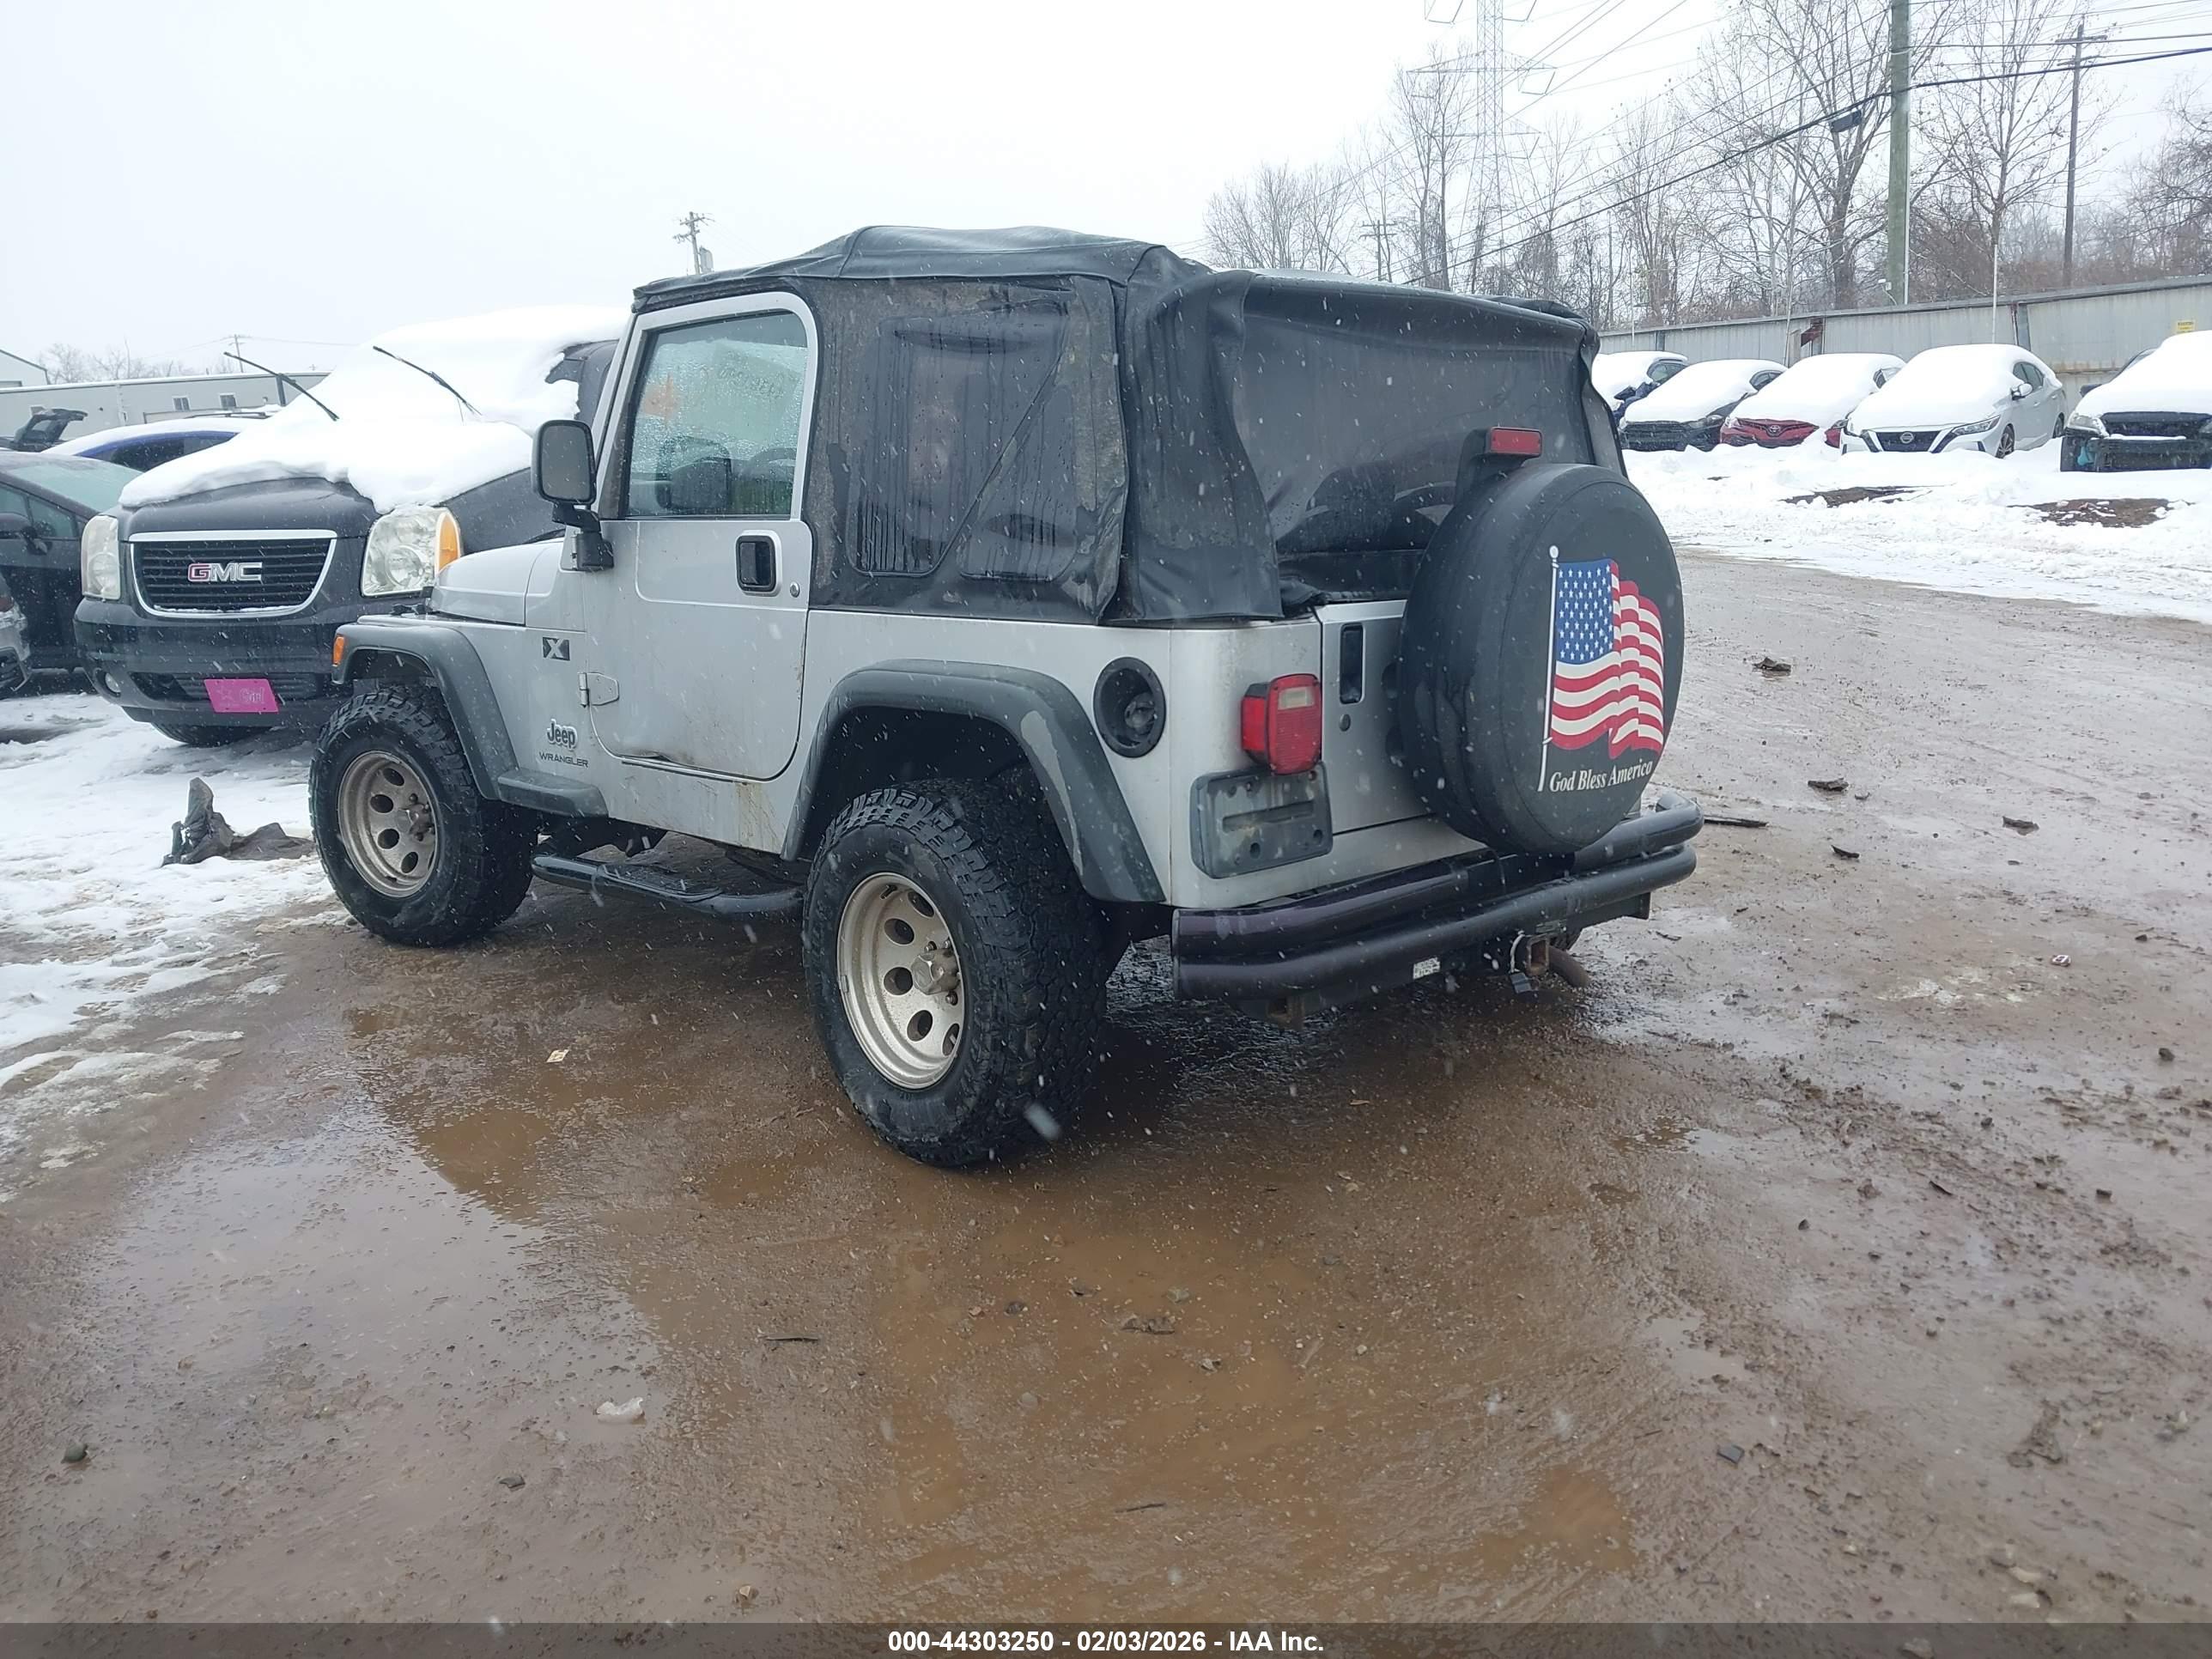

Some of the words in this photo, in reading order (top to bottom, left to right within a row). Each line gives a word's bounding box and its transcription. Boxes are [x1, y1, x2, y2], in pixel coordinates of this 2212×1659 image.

[187, 562, 263, 582] GMC
[546, 719, 577, 750] Jeep
[538, 751, 589, 769] WRANGLER
[1549, 770, 1577, 793] God
[1577, 769, 1607, 791] Bless
[1607, 758, 1653, 787] America
